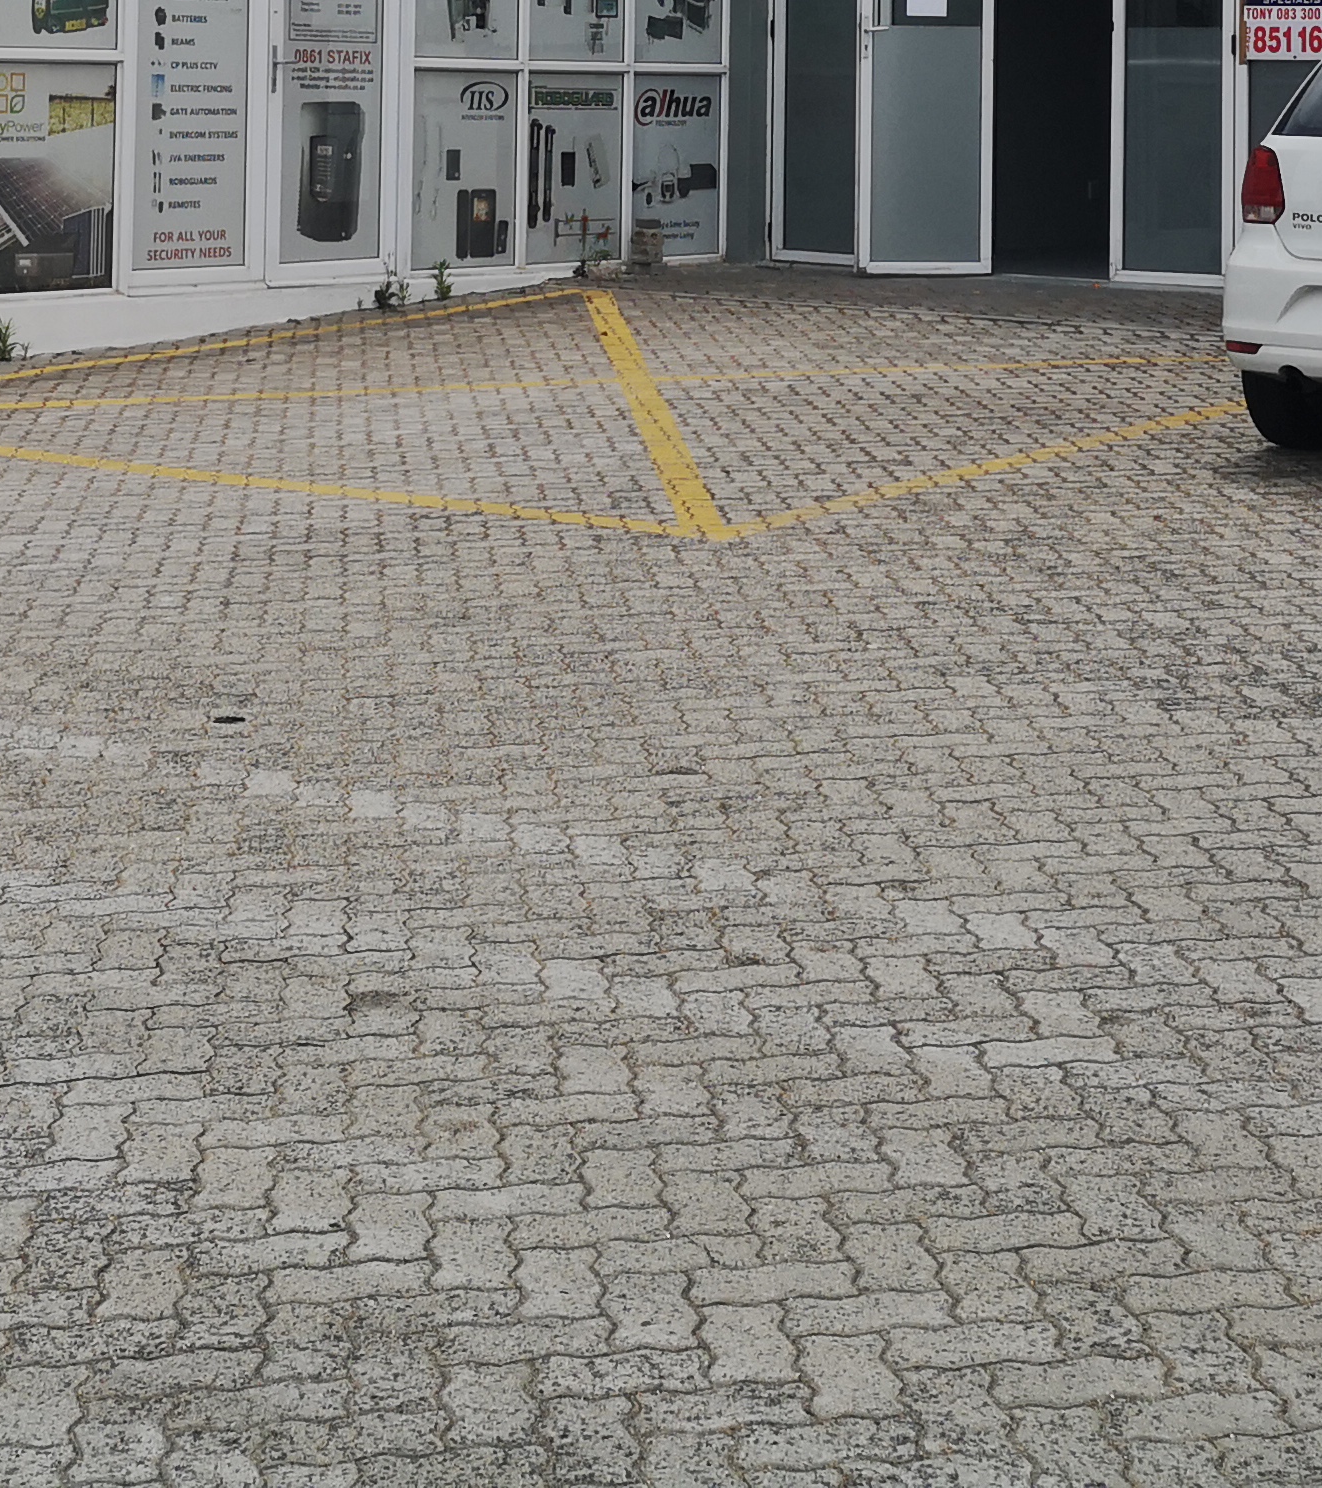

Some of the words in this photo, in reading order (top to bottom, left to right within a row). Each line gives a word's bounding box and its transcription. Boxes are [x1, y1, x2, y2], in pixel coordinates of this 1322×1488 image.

[1245, 7, 1273, 20] TONY
[1277, 7, 1297, 20] 083
[1300, 7, 1321, 20] 300
[171, 14, 208, 23] BATTERIES
[171, 38, 196, 46] BEAMS
[1253, 25, 1292, 53] 851
[294, 49, 323, 63] 0861
[327, 50, 372, 65] STAFIX
[170, 61, 180, 70] CP
[200, 62, 218, 70] CCTV
[170, 84, 202, 93] ELECTRIC
[202, 85, 233, 93] FENCING
[534, 91, 615, 107] ROBOGUARD
[170, 108, 188, 116] GATE
[189, 108, 238, 116] AUTOMATION
[169, 131, 206, 139] INTERCOM
[207, 130, 239, 139] SYSTEMS
[183, 153, 226, 162] ENERGIZERS
[168, 177, 218, 186] ROBOGUARDS
[168, 200, 201, 209] REMOTES
[1292, 223, 1312, 231] VIVO
[153, 231, 174, 243] FOR
[176, 230, 196, 242] ALL
[198, 229, 227, 241] YOUR
[146, 248, 197, 261] SECURITY
[199, 246, 232, 259] NEEDS
